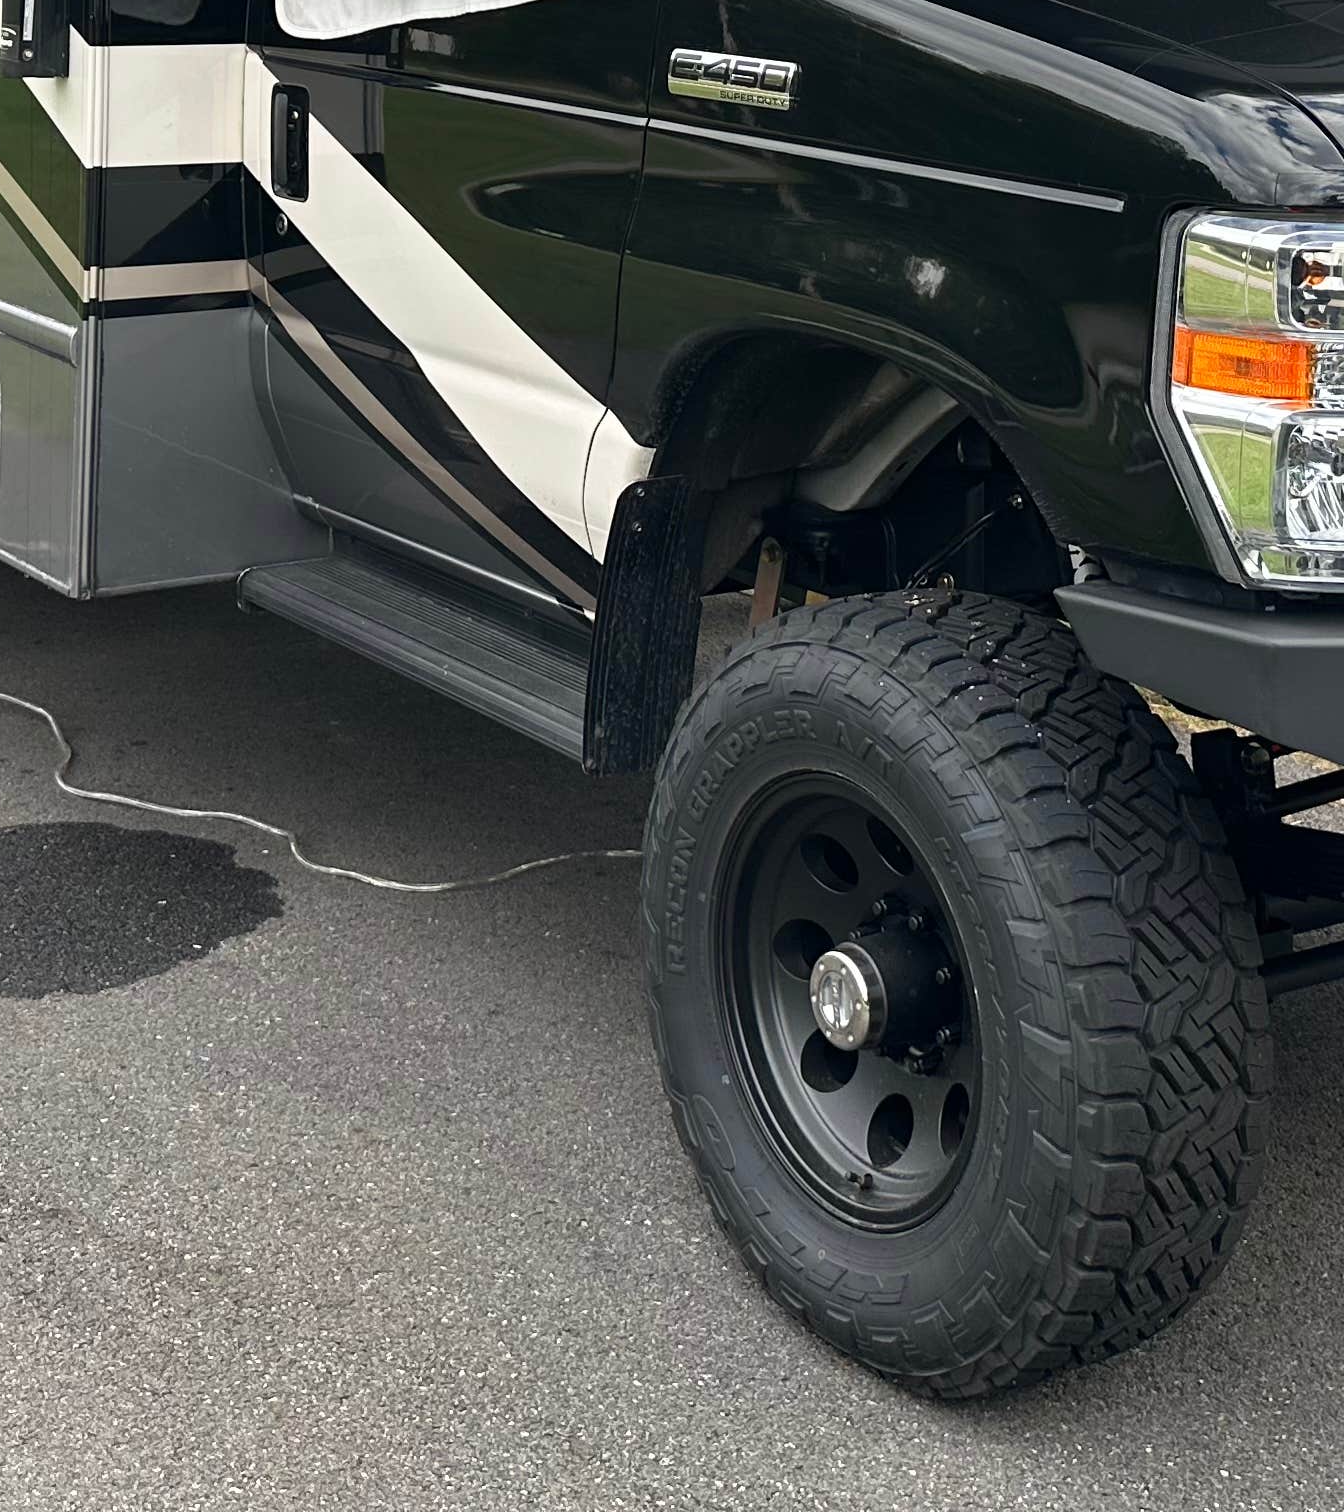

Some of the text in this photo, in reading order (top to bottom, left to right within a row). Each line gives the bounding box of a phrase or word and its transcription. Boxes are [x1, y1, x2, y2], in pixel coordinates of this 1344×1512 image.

[670, 53, 792, 92] E-450
[720, 90, 787, 107] SUPER DUTY
[665, 826, 697, 975] RECON
[689, 709, 817, 822] GRAPPLER
